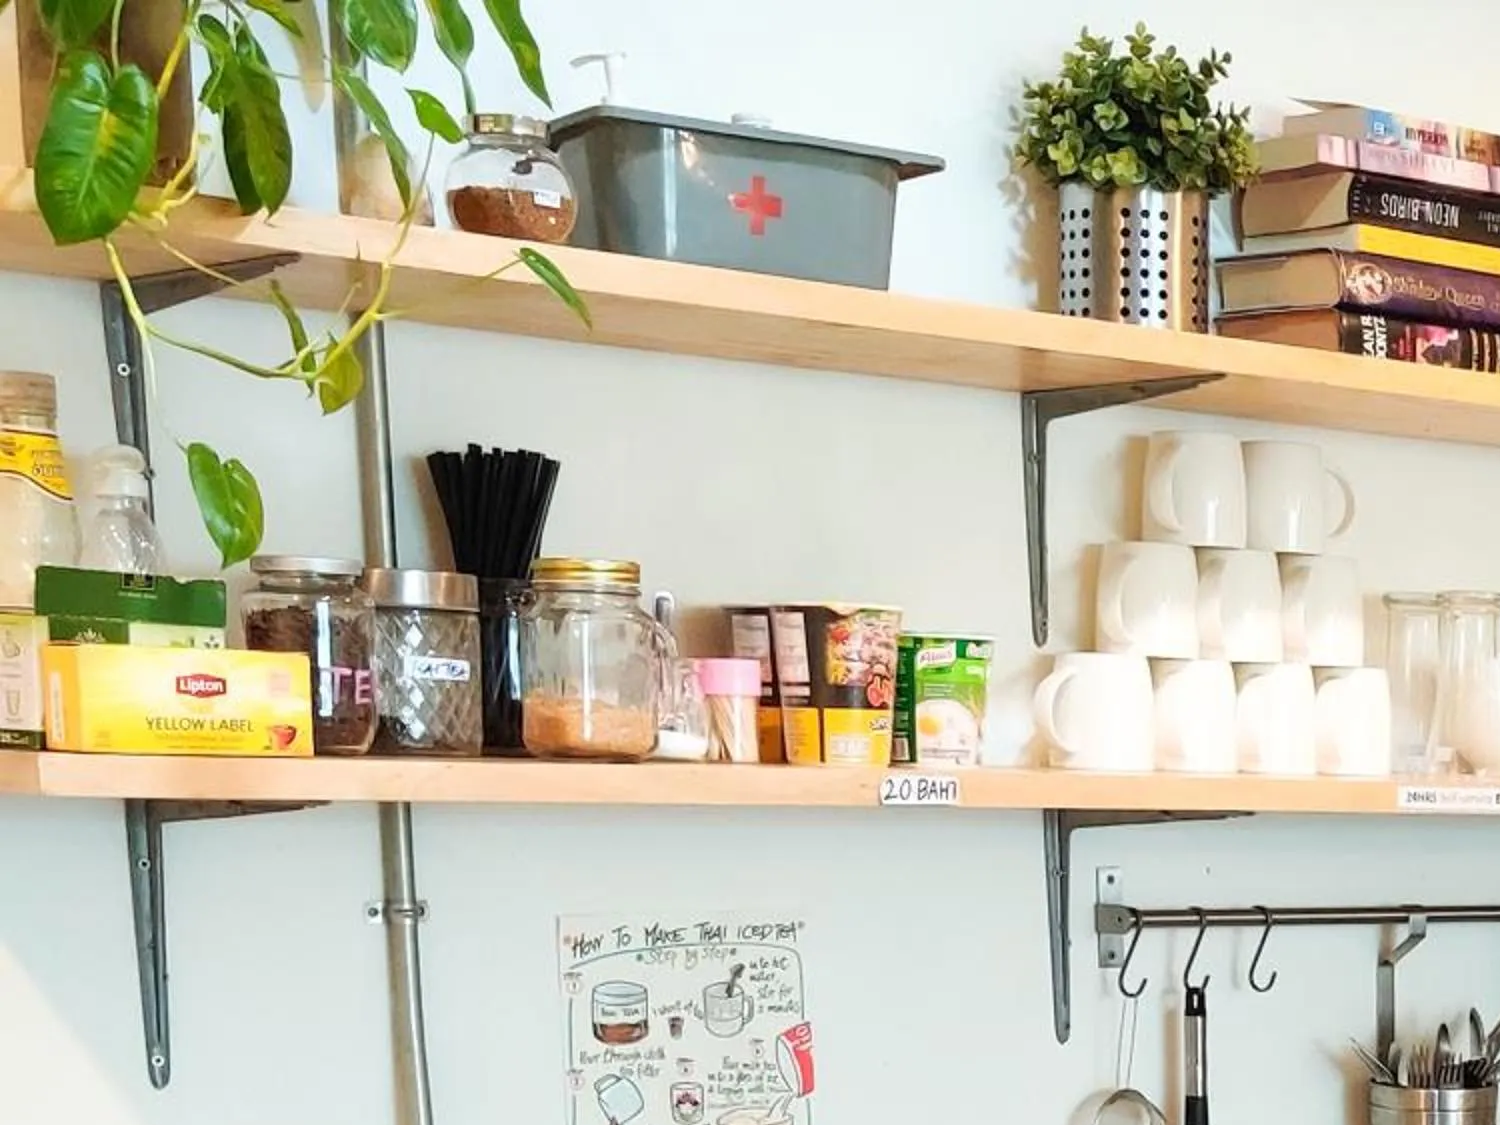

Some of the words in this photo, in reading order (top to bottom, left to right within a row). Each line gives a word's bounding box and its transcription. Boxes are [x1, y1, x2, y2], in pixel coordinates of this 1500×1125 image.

[179, 676, 224, 694] Lipton
[145, 716, 207, 732] YELLOW
[209, 717, 256, 734] LABEL
[883, 778, 913, 801] 20
[611, 924, 633, 948] TO
[643, 922, 688, 947] MAKE
[693, 921, 728, 942] THAI
[737, 923, 773, 941] ICED
